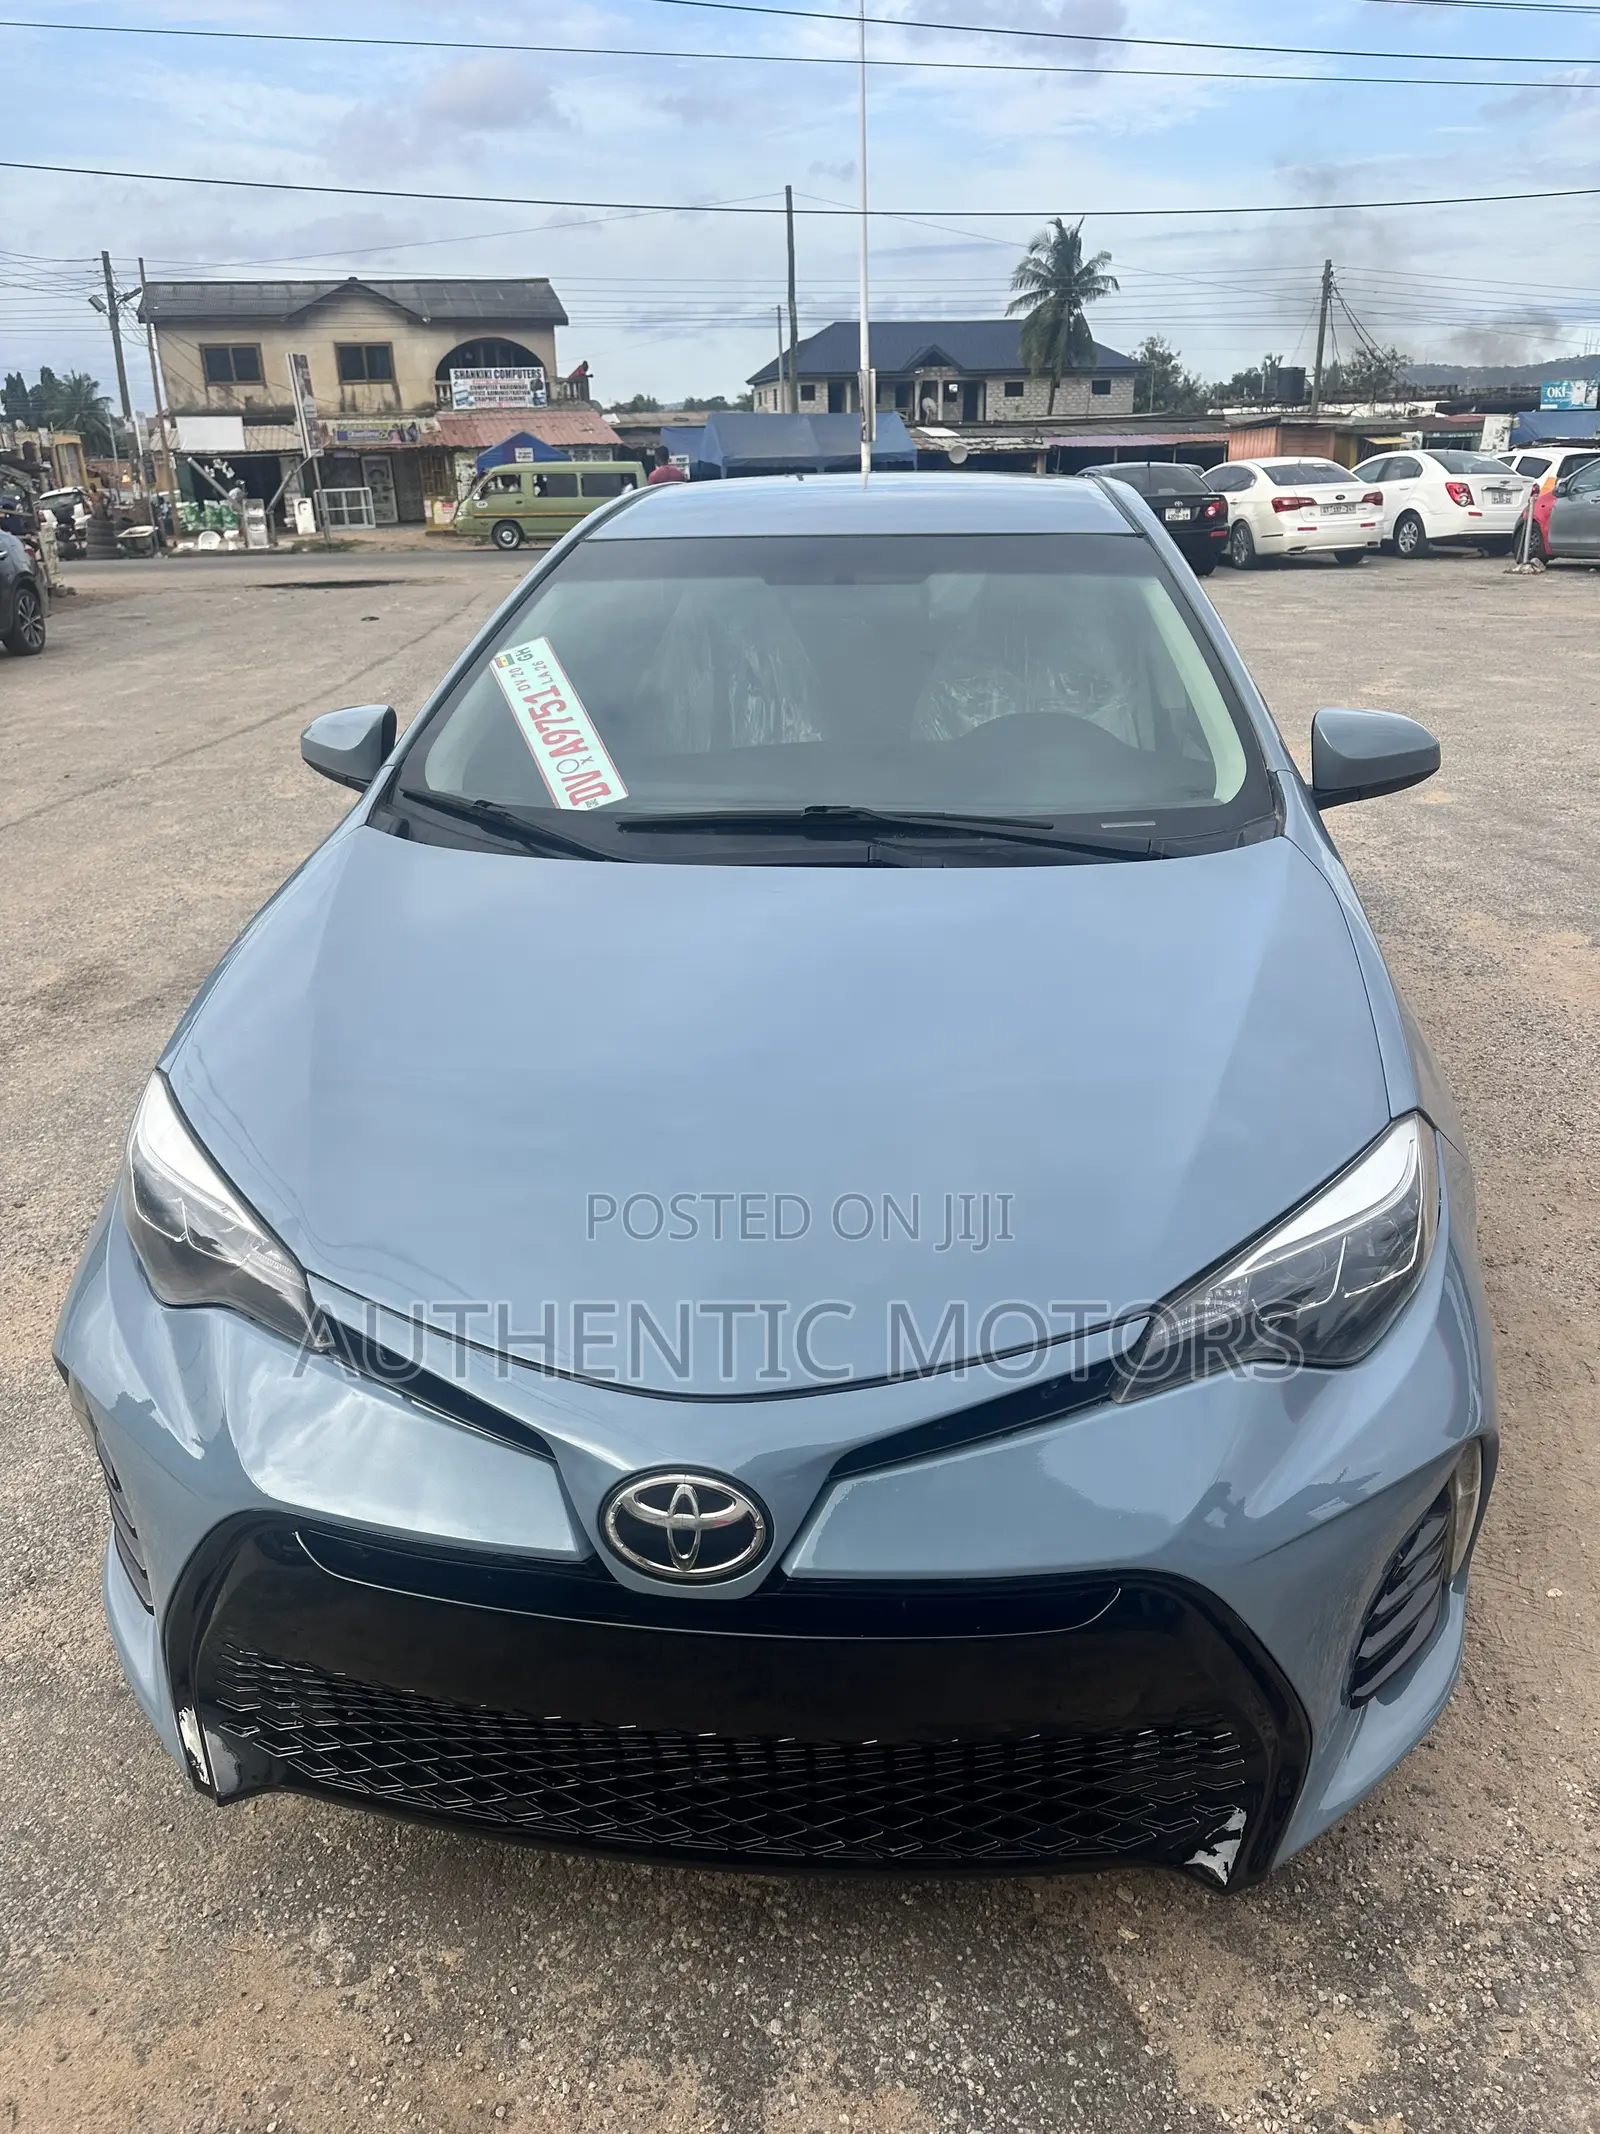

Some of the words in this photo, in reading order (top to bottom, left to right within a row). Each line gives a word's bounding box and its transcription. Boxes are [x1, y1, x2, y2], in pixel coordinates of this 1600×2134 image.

[454, 369, 492, 380] SHANKIKI
[493, 369, 541, 379] COMPUTERS
[516, 646, 534, 662] GH
[532, 660, 548, 672] 26
[509, 667, 524, 679] 20
[538, 671, 554, 685] LA
[515, 679, 531, 692] DV
[522, 685, 589, 758] A9751
[561, 769, 612, 807] DV
